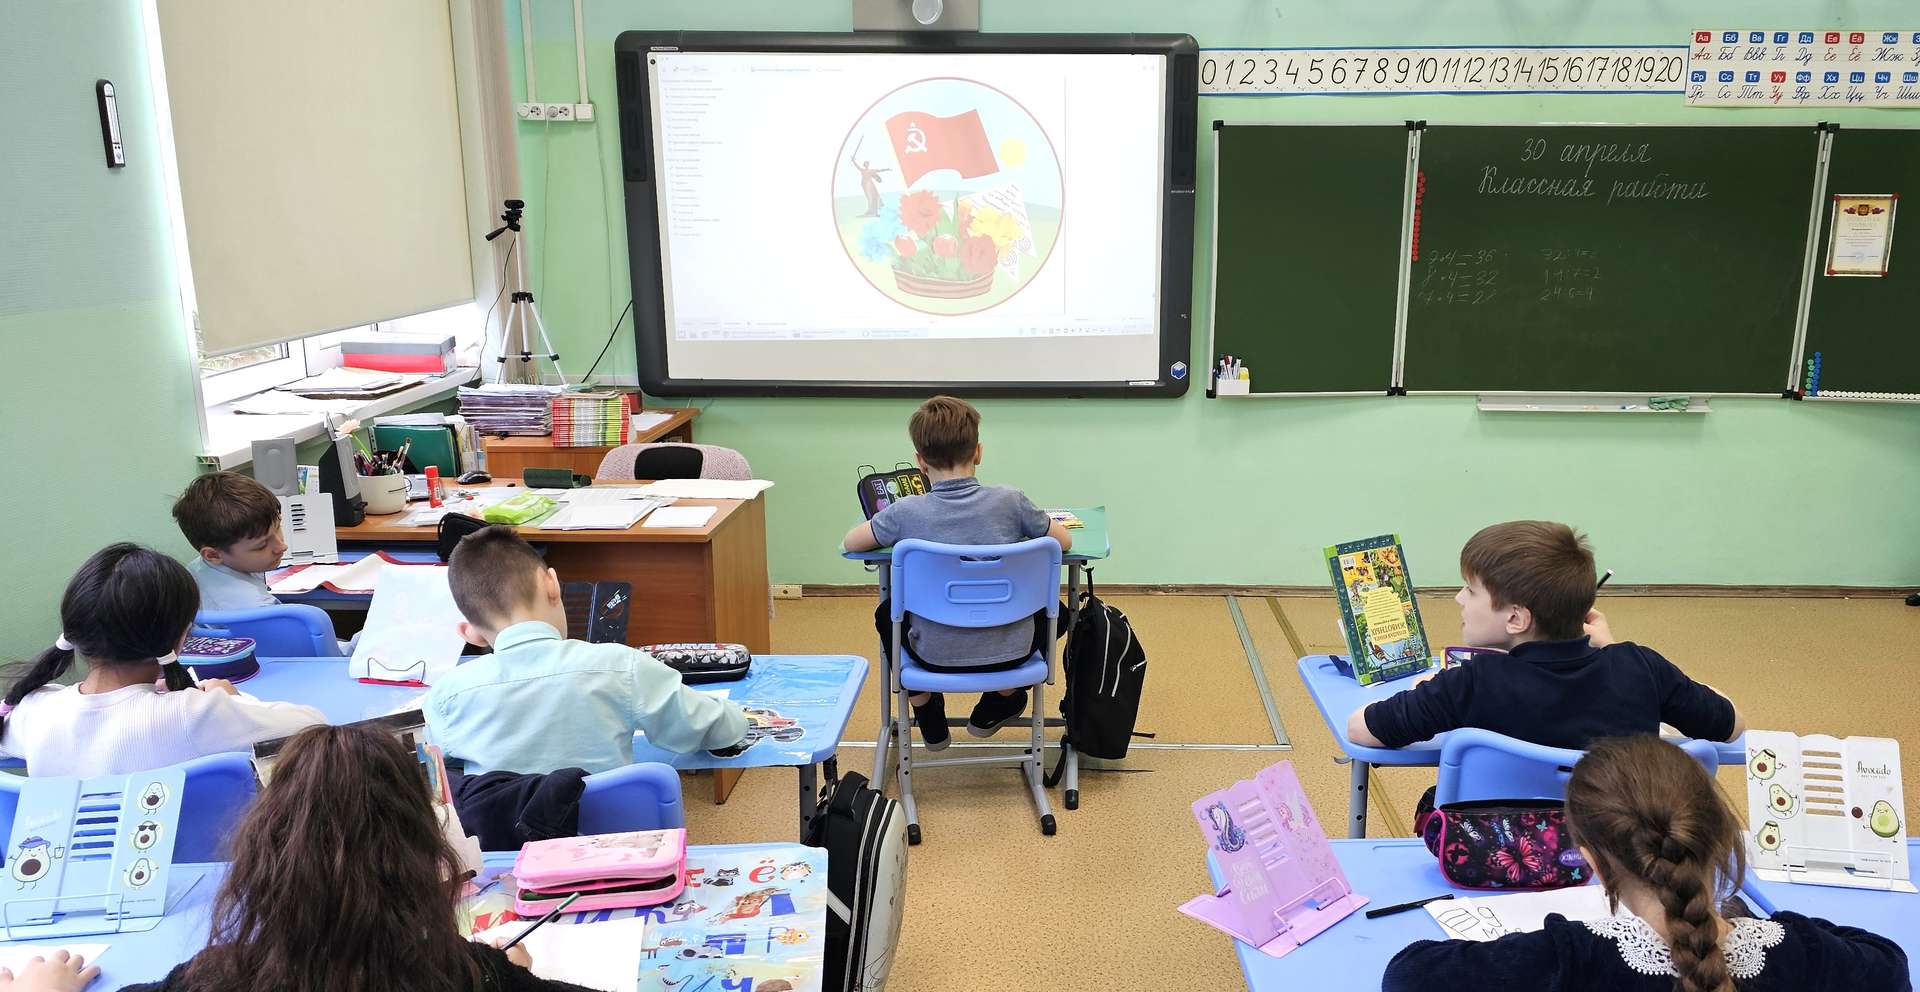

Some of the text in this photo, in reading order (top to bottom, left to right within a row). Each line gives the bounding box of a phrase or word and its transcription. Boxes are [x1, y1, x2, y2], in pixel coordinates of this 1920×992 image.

[1691, 46, 1712, 60] Аа
[1718, 46, 1741, 60] Бб
[1201, 57, 1683, 85] 0 1 2 3 4 5 6 7 8 9 10 11 12 13 14 15 16 17 18 19 20
[1520, 138, 1652, 178] 30 апреля
[1478, 165, 1709, 205] Классная работа
[655, 643, 718, 651] MARVEL
